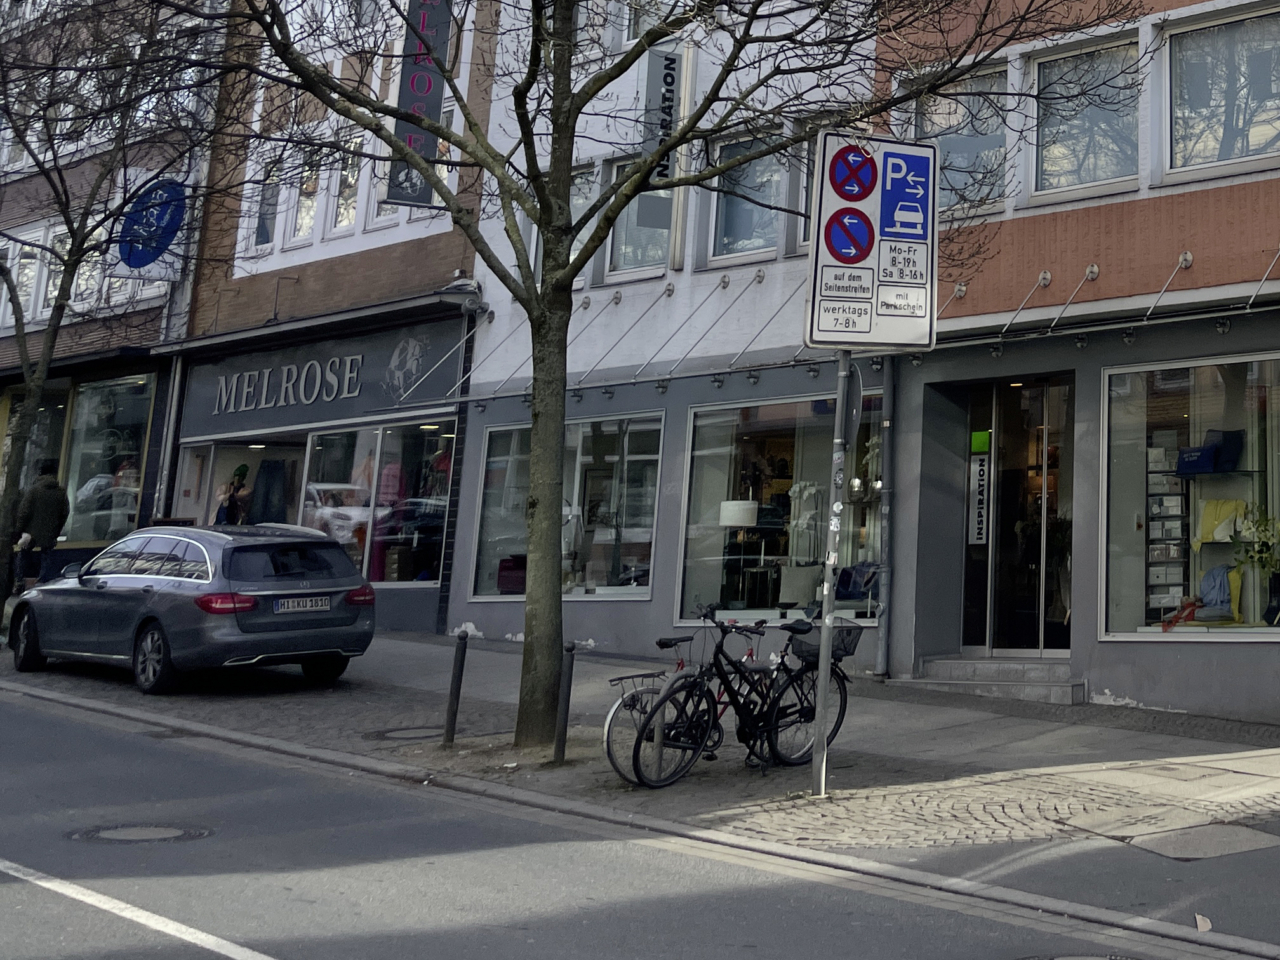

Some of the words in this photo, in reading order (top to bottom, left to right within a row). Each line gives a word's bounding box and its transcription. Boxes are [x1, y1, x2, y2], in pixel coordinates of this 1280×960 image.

[885, 157, 907, 191] P
[889, 245, 918, 256] Mo-Fr
[834, 272, 845, 281] auf
[848, 273, 862, 281] dem
[882, 268, 894, 278] Sa
[824, 283, 870, 294] Seitenstreifen
[823, 305, 869, 317] werktags
[880, 301, 923, 311] Parkschein
[212, 355, 364, 416] MELROSE
